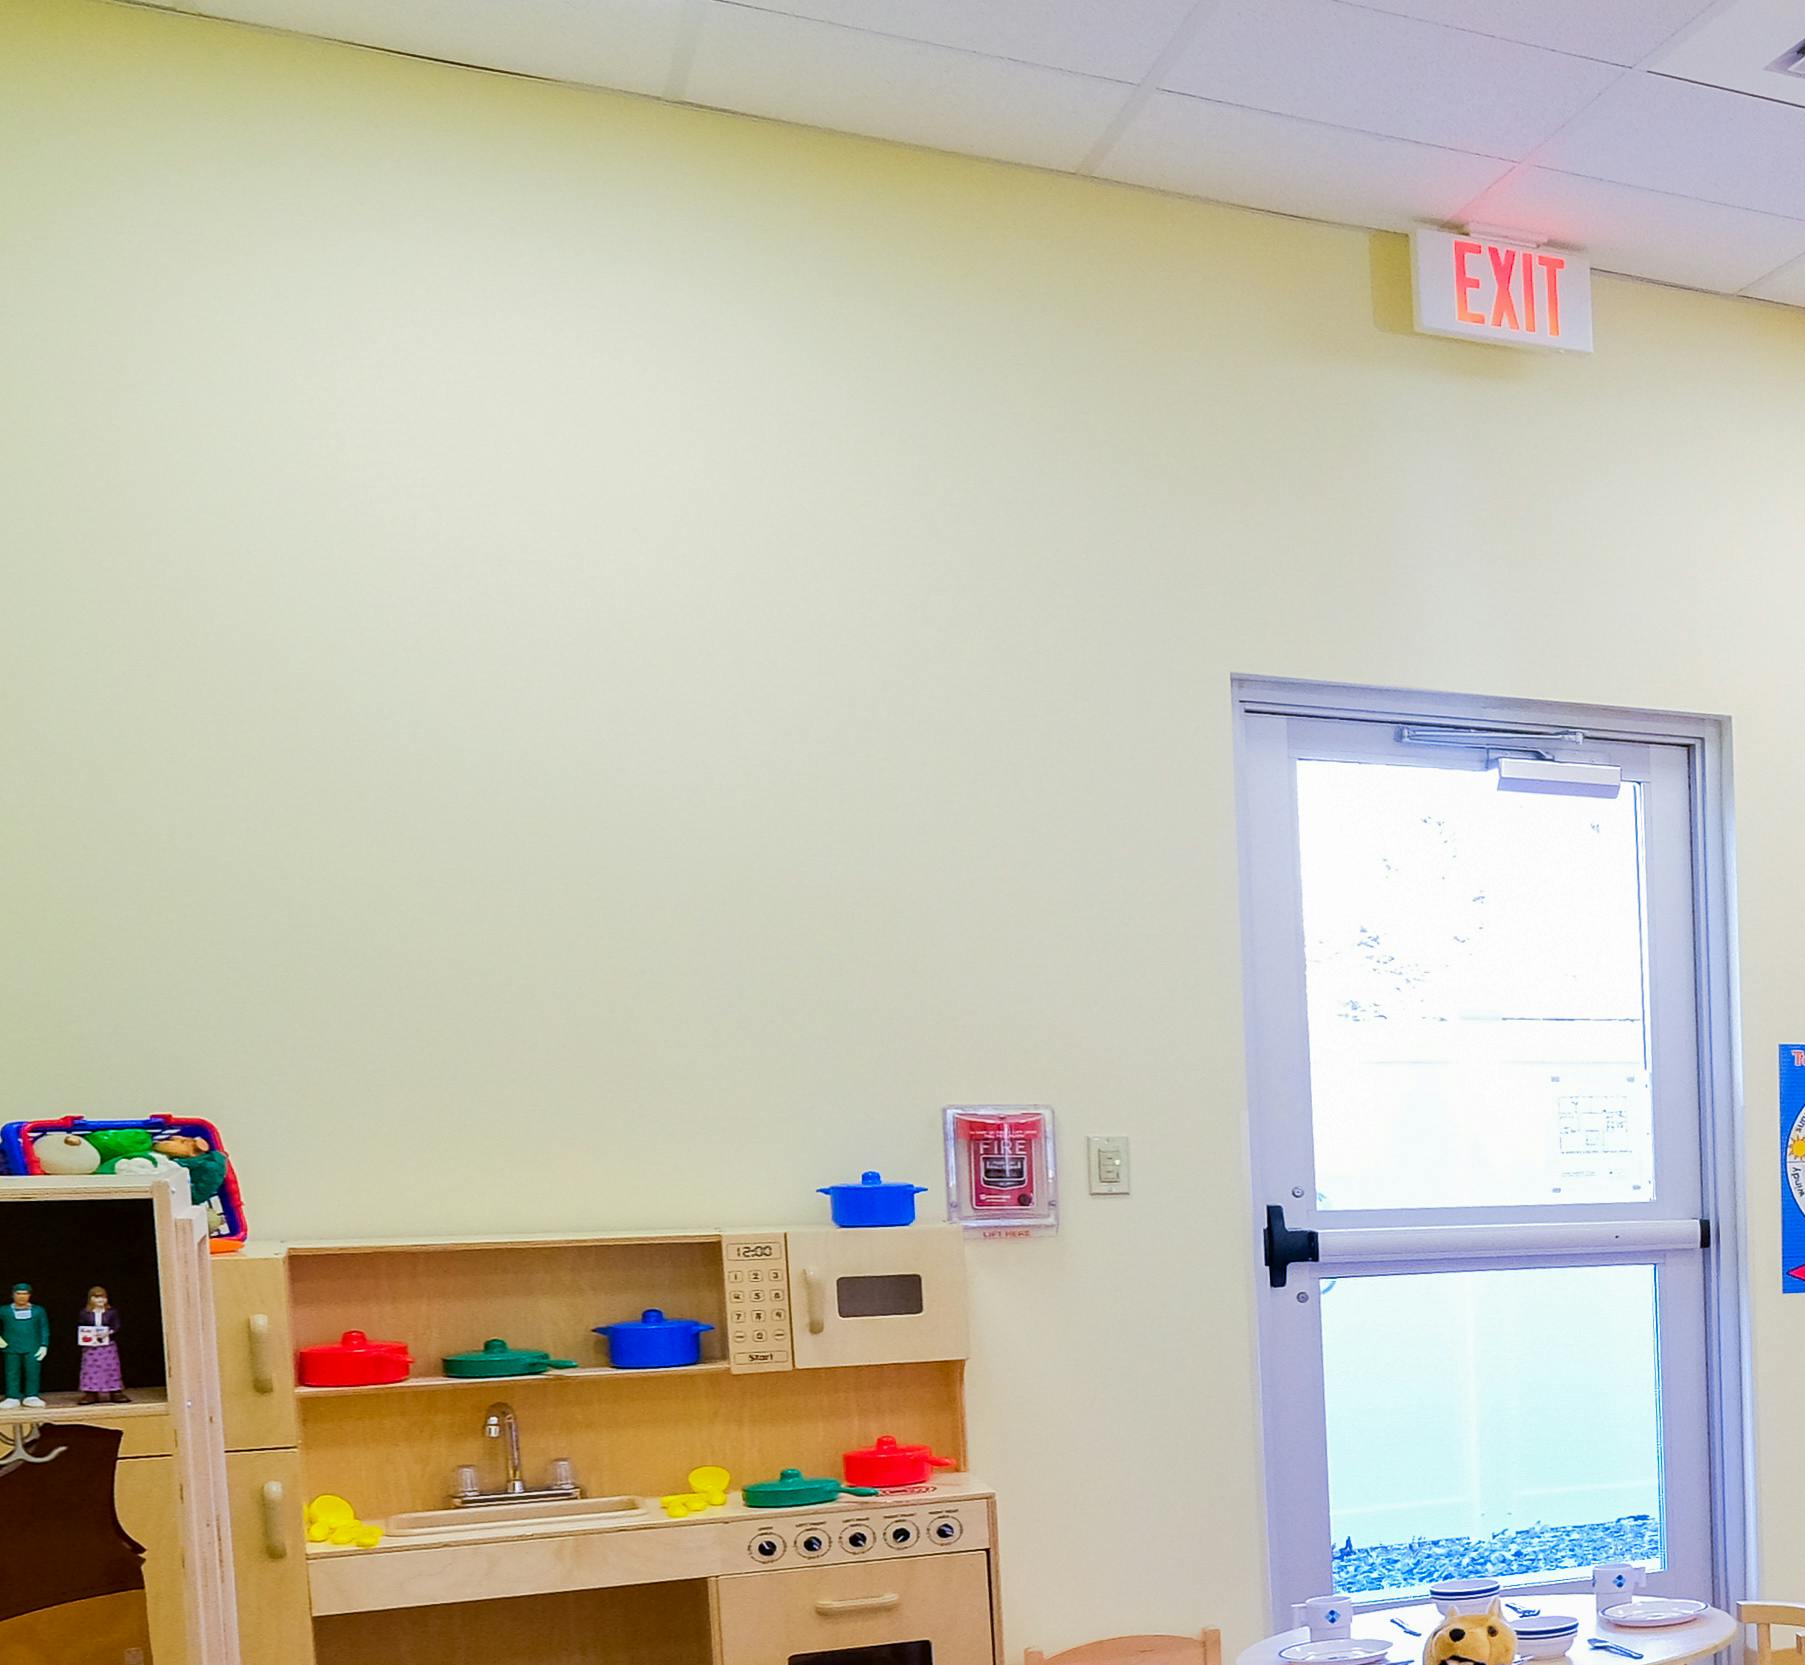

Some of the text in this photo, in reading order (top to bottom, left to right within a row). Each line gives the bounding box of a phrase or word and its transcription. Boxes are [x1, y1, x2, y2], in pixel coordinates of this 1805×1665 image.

[1454, 239, 1566, 337] EXIT
[980, 1140, 1027, 1154] FIRE
[1791, 1166, 1805, 1198] windy
[737, 1245, 772, 1257] 12:00
[752, 1272, 759, 1280] 2
[772, 1271, 779, 1279] 3
